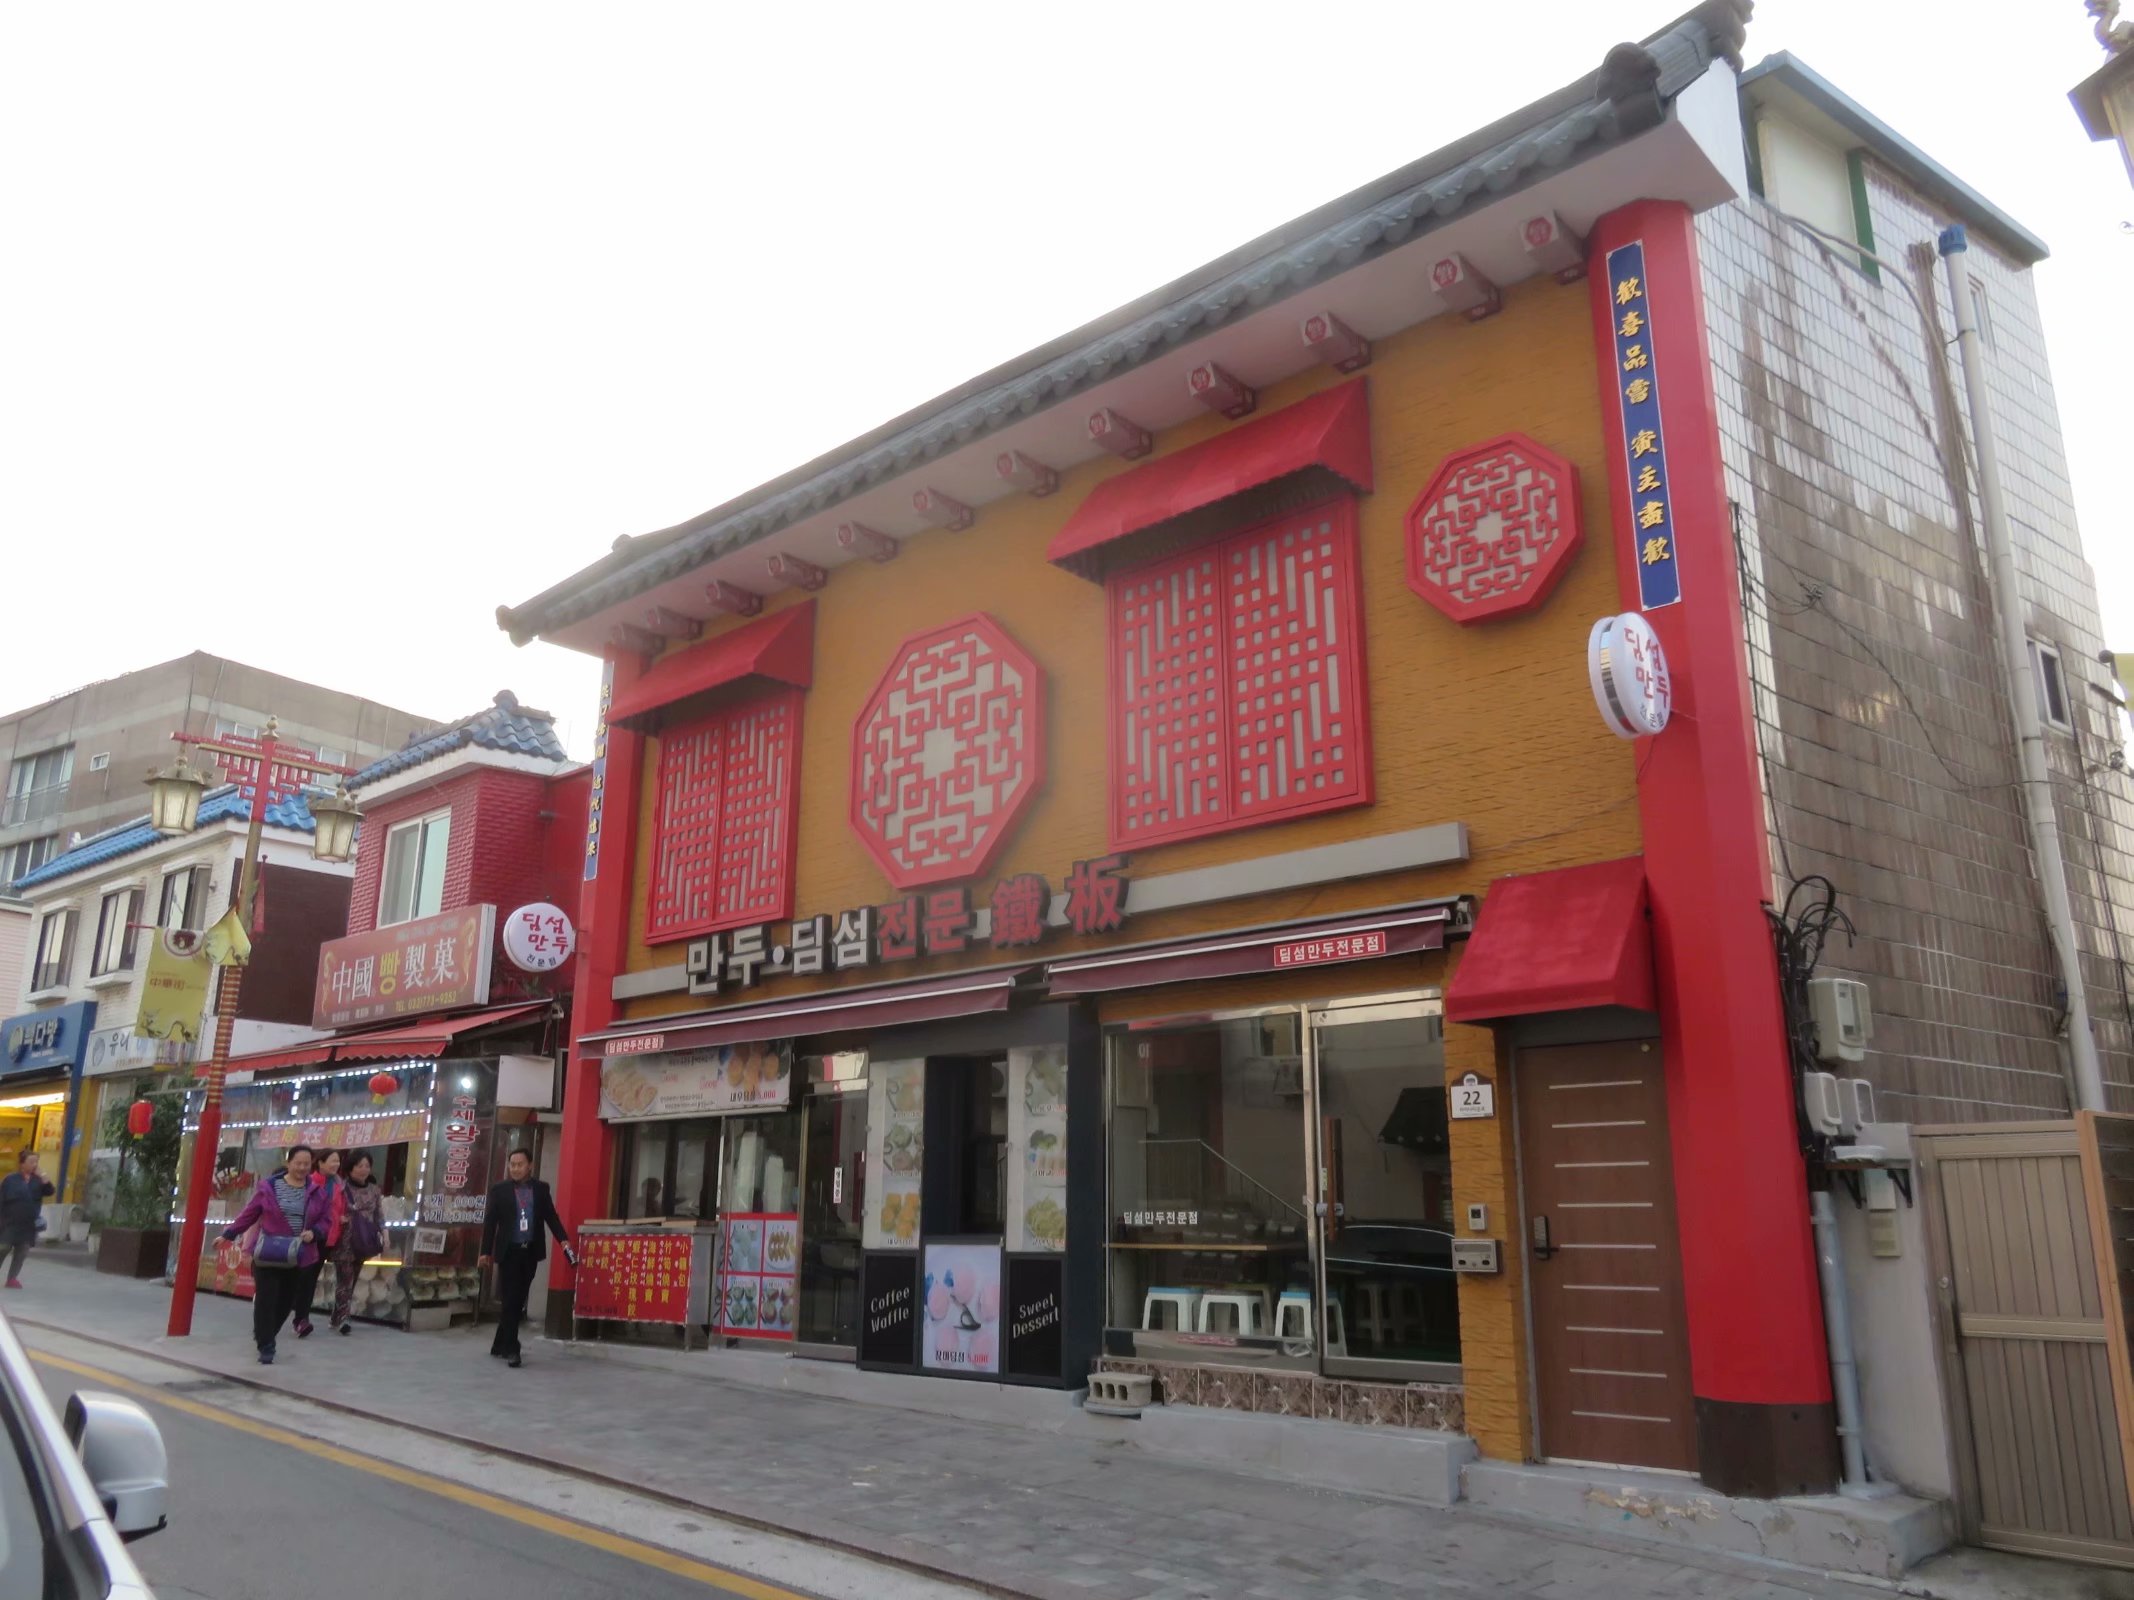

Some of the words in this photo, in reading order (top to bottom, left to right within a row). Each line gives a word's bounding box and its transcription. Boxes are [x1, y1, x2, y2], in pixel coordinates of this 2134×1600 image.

[1624, 626, 1663, 672] 딤섬
[1636, 665, 1669, 709] 만두
[522, 913, 565, 934] 딤섬
[528, 934, 568, 955] 만두
[1279, 935, 1379, 963] 딤섬만두전문점
[1462, 1091, 1481, 1105] 22
[1123, 1210, 1198, 1225] 딤섬만두전문점
[870, 1286, 910, 1314] Coffee
[1019, 1292, 1054, 1319] Sweet
[871, 1306, 909, 1334] Waffle
[1012, 1306, 1060, 1339] Dessert
